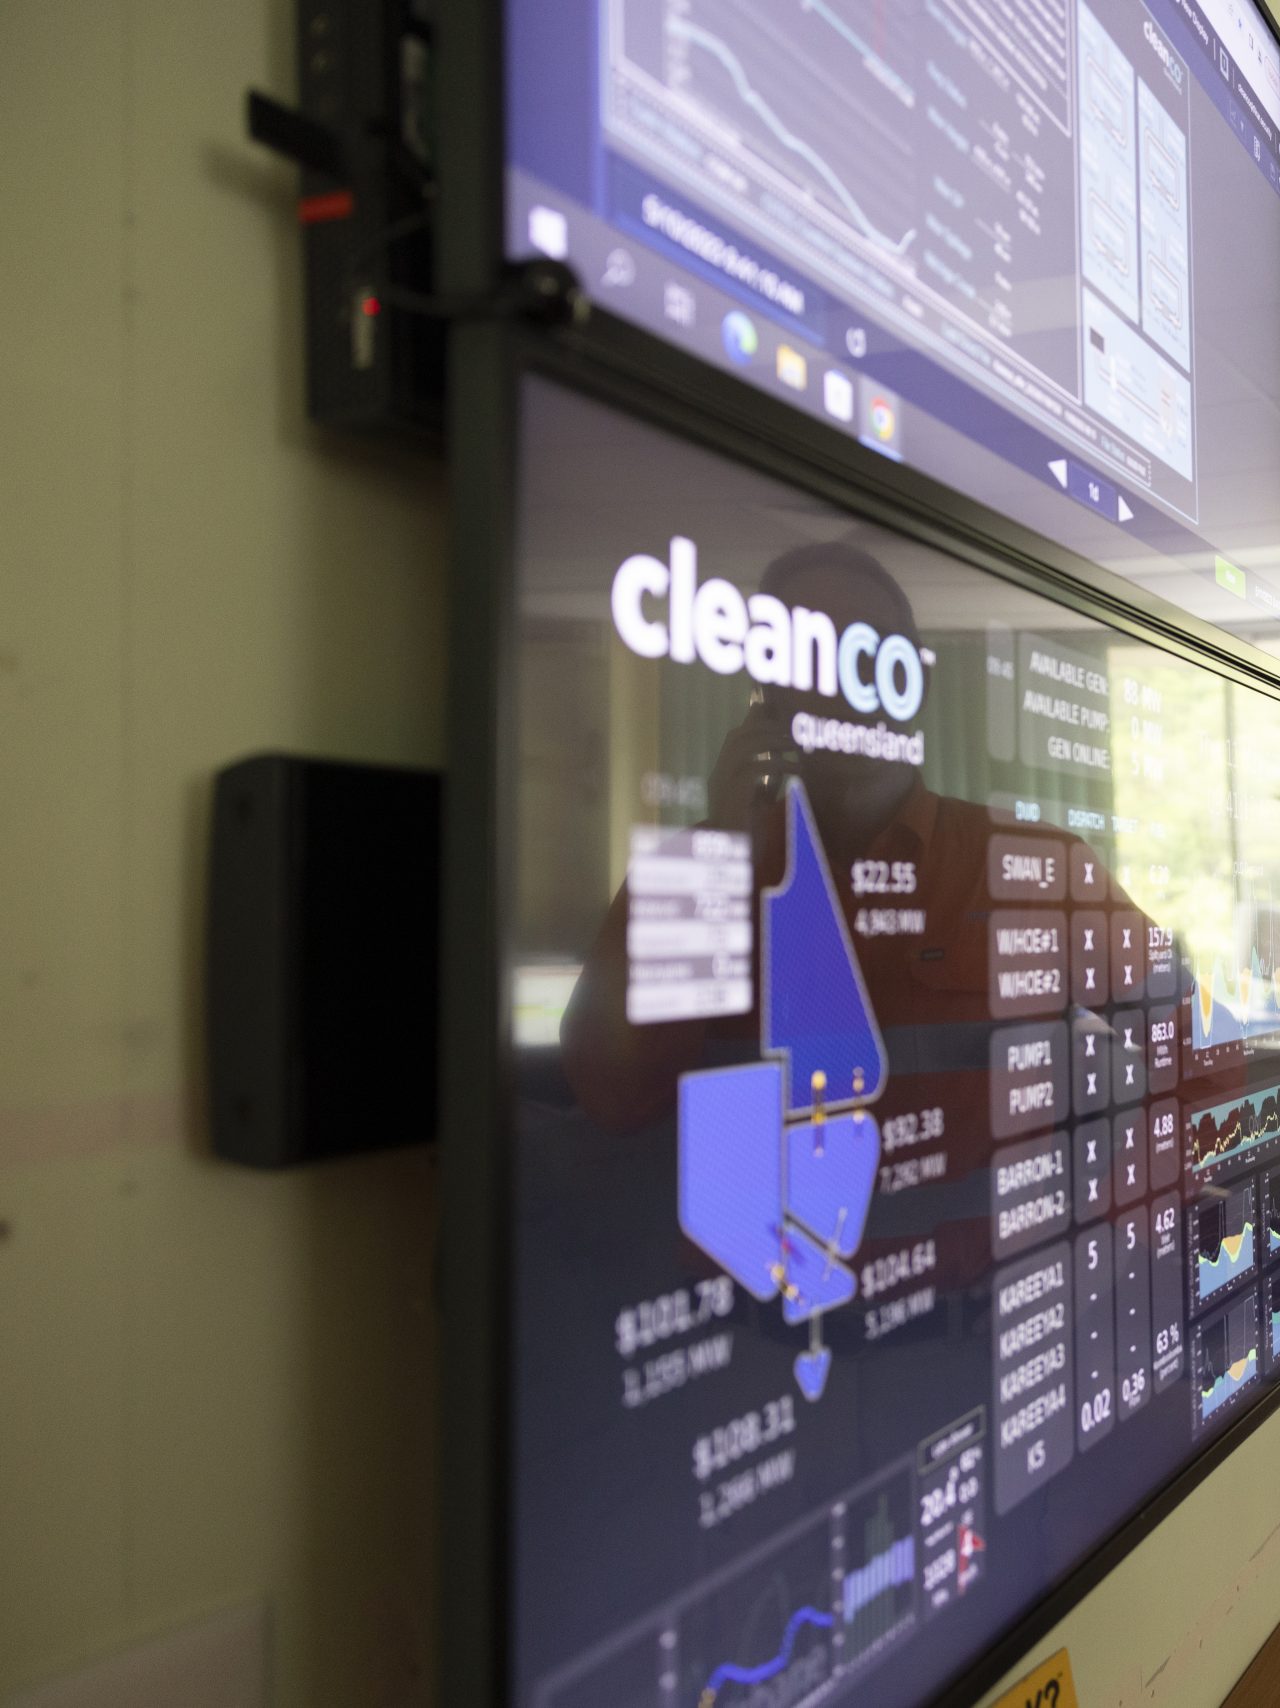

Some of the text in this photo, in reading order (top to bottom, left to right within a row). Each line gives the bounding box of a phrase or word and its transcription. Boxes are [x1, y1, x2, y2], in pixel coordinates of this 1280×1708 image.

[1029, 651, 1085, 688] AVAILABLE
[1023, 689, 1080, 725] AVAILABLE
[1048, 736, 1072, 760] GEN
[850, 857, 917, 898] $22.55
[1148, 927, 1173, 948] 157.9
[1151, 1020, 1175, 1043] 863.0
[1008, 1041, 1052, 1072] PUMP1
[1009, 1082, 1054, 1115] PUMP2
[1153, 1113, 1174, 1137] 4.88
[997, 1149, 1064, 1196] BARRON-1
[999, 1189, 1066, 1240] BARRON-2
[1155, 1207, 1175, 1234] 4.62
[999, 1261, 1064, 1316] KAREEYA1
[1087, 1240, 1099, 1270] 5
[1126, 1221, 1136, 1250] 5
[999, 1302, 1065, 1360] KAREEYA2
[1156, 1329, 1169, 1354] 63
[1000, 1342, 1066, 1404] KAREEYA3
[1000, 1383, 1066, 1450] KAREEYA4
[1080, 1388, 1111, 1432] 0.02
[1122, 1367, 1145, 1402] 0.36
